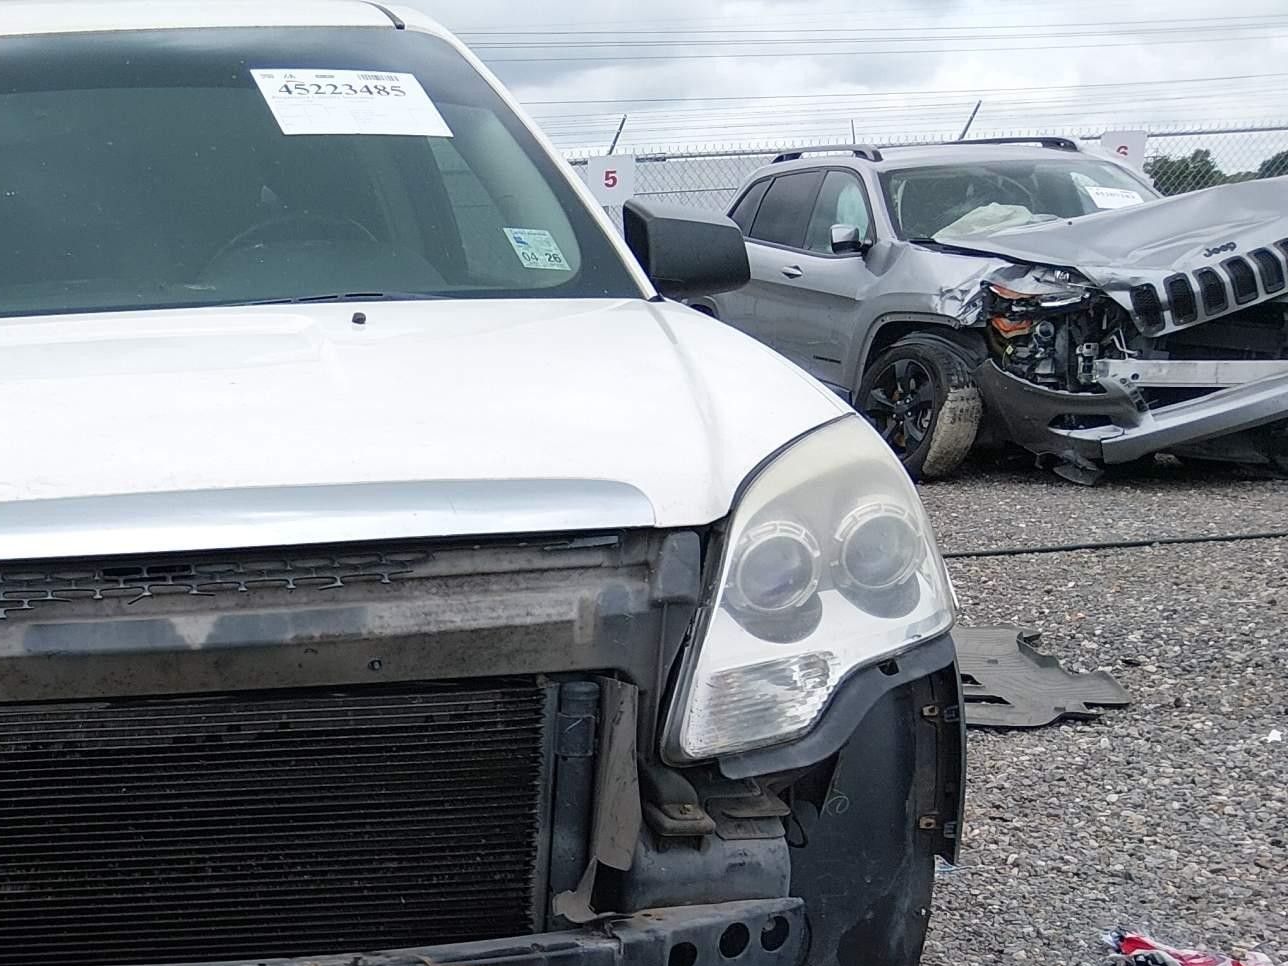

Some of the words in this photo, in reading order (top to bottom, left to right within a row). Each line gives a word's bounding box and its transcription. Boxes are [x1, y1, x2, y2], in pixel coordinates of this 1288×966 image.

[278, 83, 406, 97] 45223485
[604, 170, 618, 188] 5
[1203, 241, 1237, 258] Jeep
[522, 252, 539, 262] 04
[544, 252, 562, 263] 26
